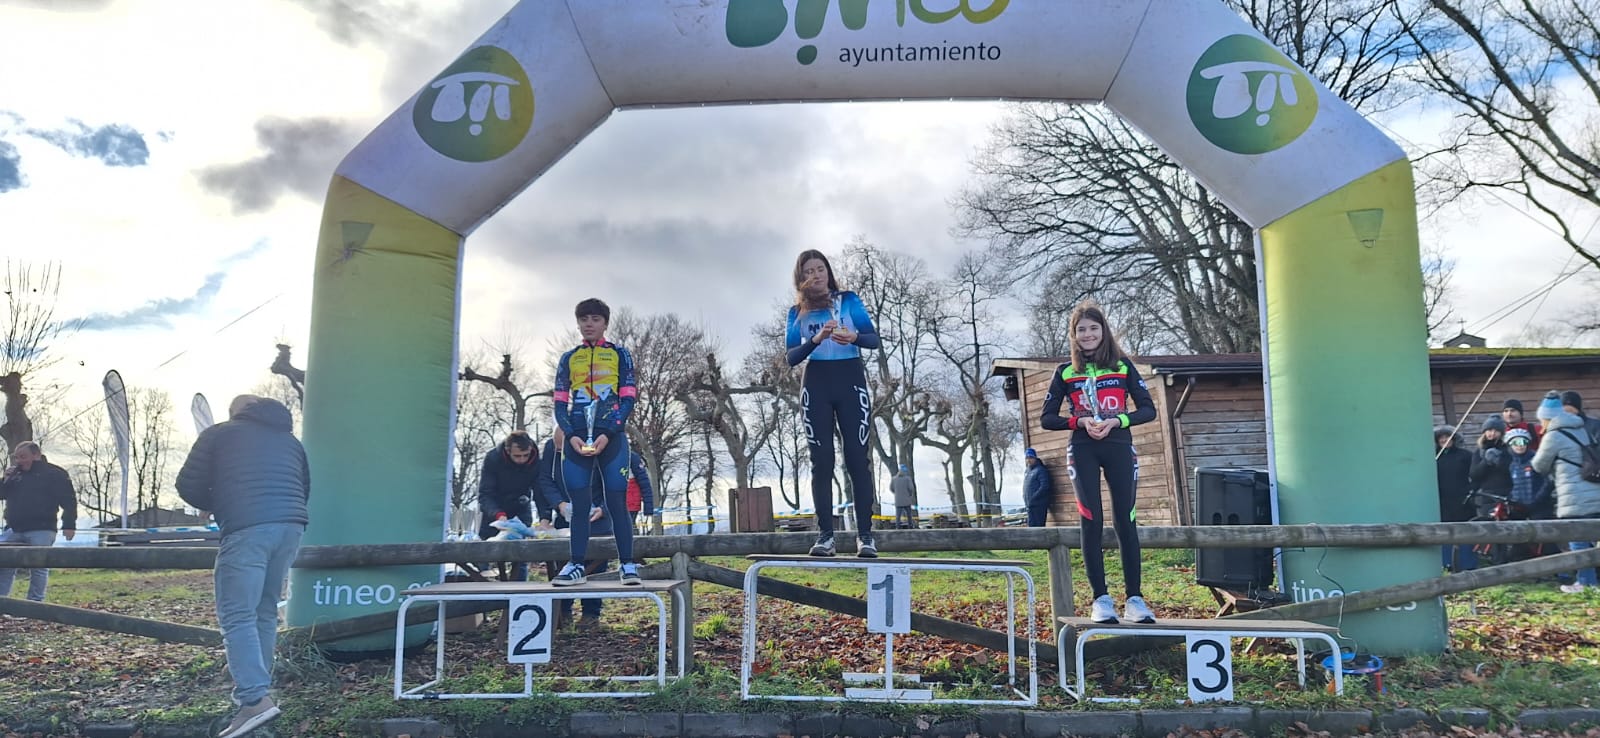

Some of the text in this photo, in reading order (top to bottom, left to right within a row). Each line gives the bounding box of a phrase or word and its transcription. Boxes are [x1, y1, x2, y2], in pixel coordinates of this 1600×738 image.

[838, 40, 1001, 67] ayuntamiento
[871, 574, 894, 627] 1
[512, 604, 547, 656] 2
[1190, 639, 1229, 694] 3
